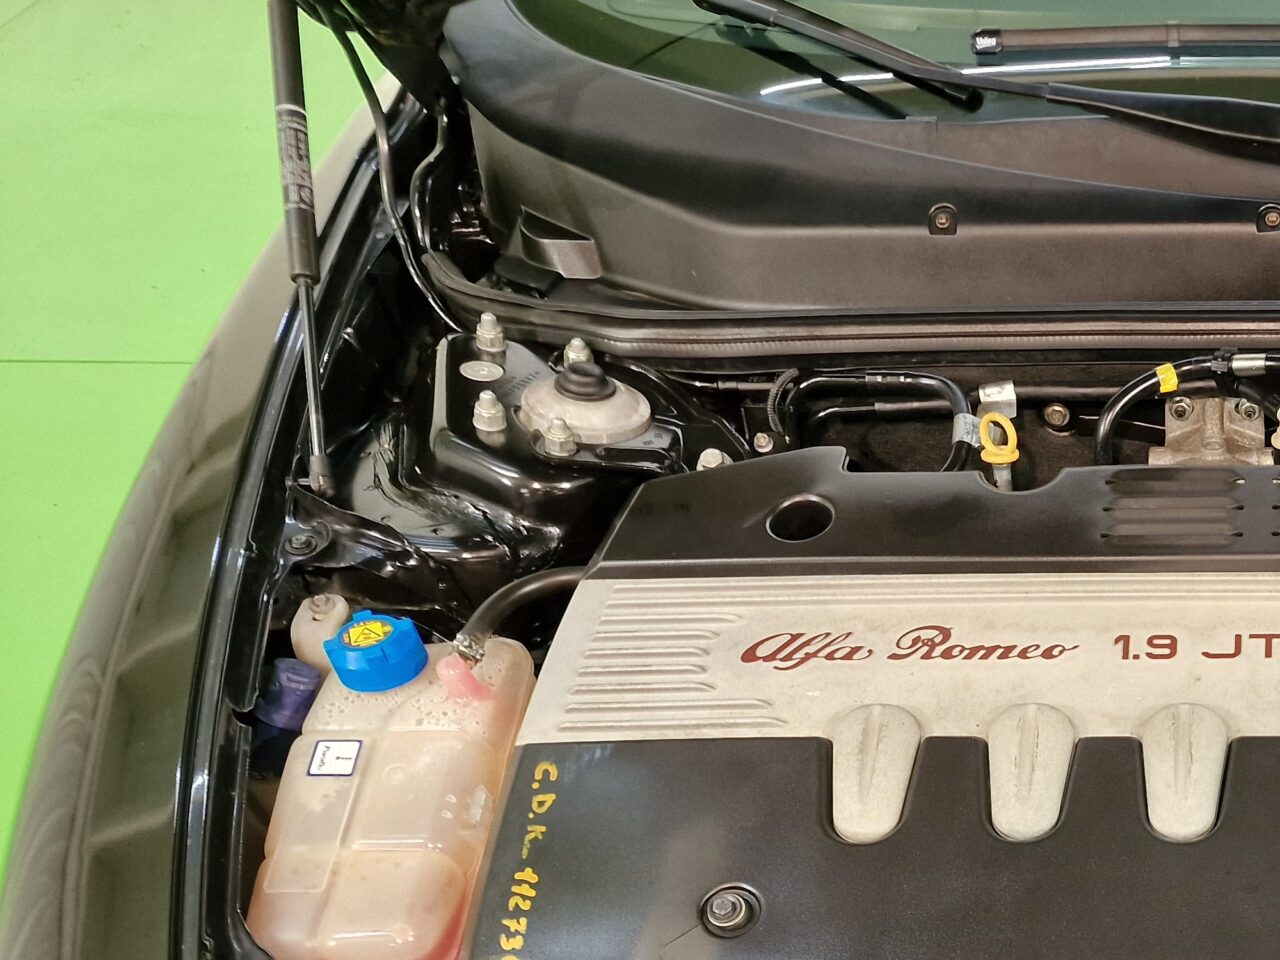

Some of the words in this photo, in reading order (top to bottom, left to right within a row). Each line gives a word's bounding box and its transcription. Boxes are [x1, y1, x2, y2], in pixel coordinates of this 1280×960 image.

[740, 631, 874, 671] Alfa
[886, 624, 1080, 661] Romeo
[1113, 633, 1178, 660] 1.9
